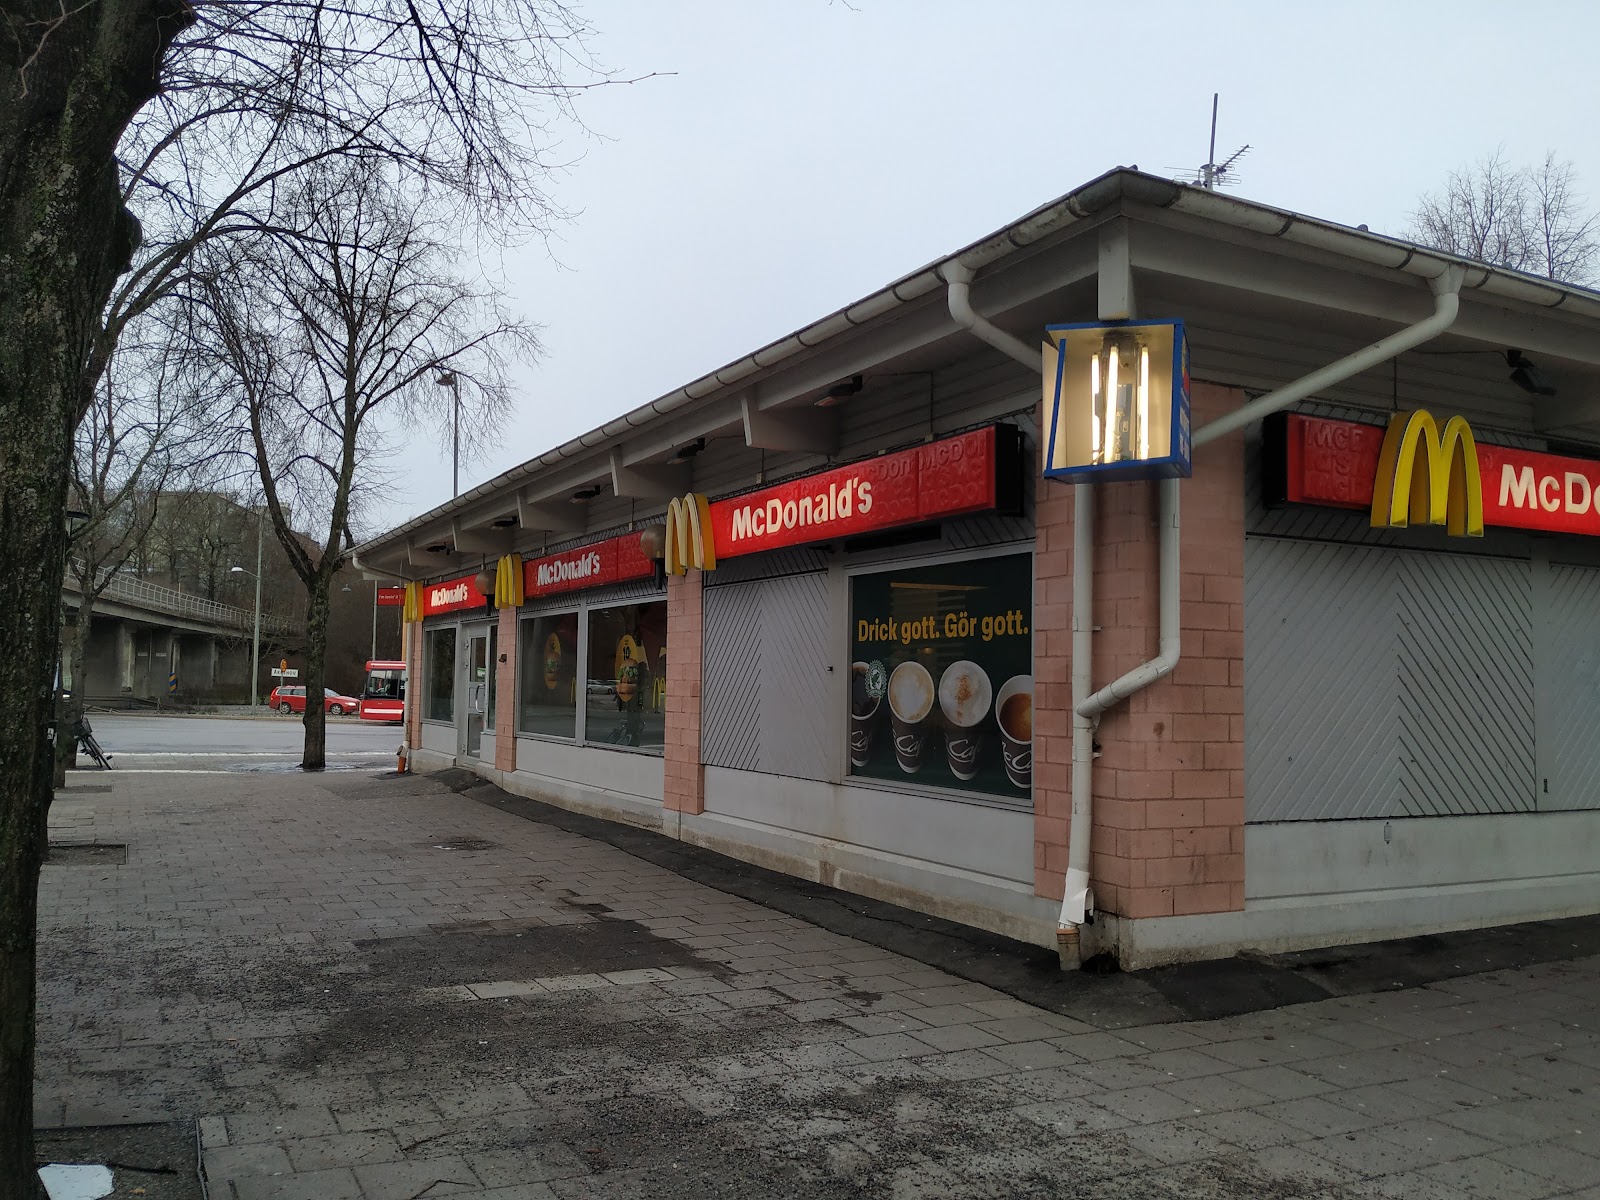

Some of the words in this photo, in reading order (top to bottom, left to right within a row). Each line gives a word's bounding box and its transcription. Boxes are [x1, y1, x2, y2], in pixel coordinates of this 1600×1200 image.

[731, 477, 873, 542] McDonald's
[537, 551, 601, 587] McDonald's
[431, 583, 468, 607] McDonald's
[858, 617, 898, 642] Drick
[901, 615, 940, 645] gott.
[945, 611, 977, 638] Gör
[981, 609, 1029, 642] gott.
